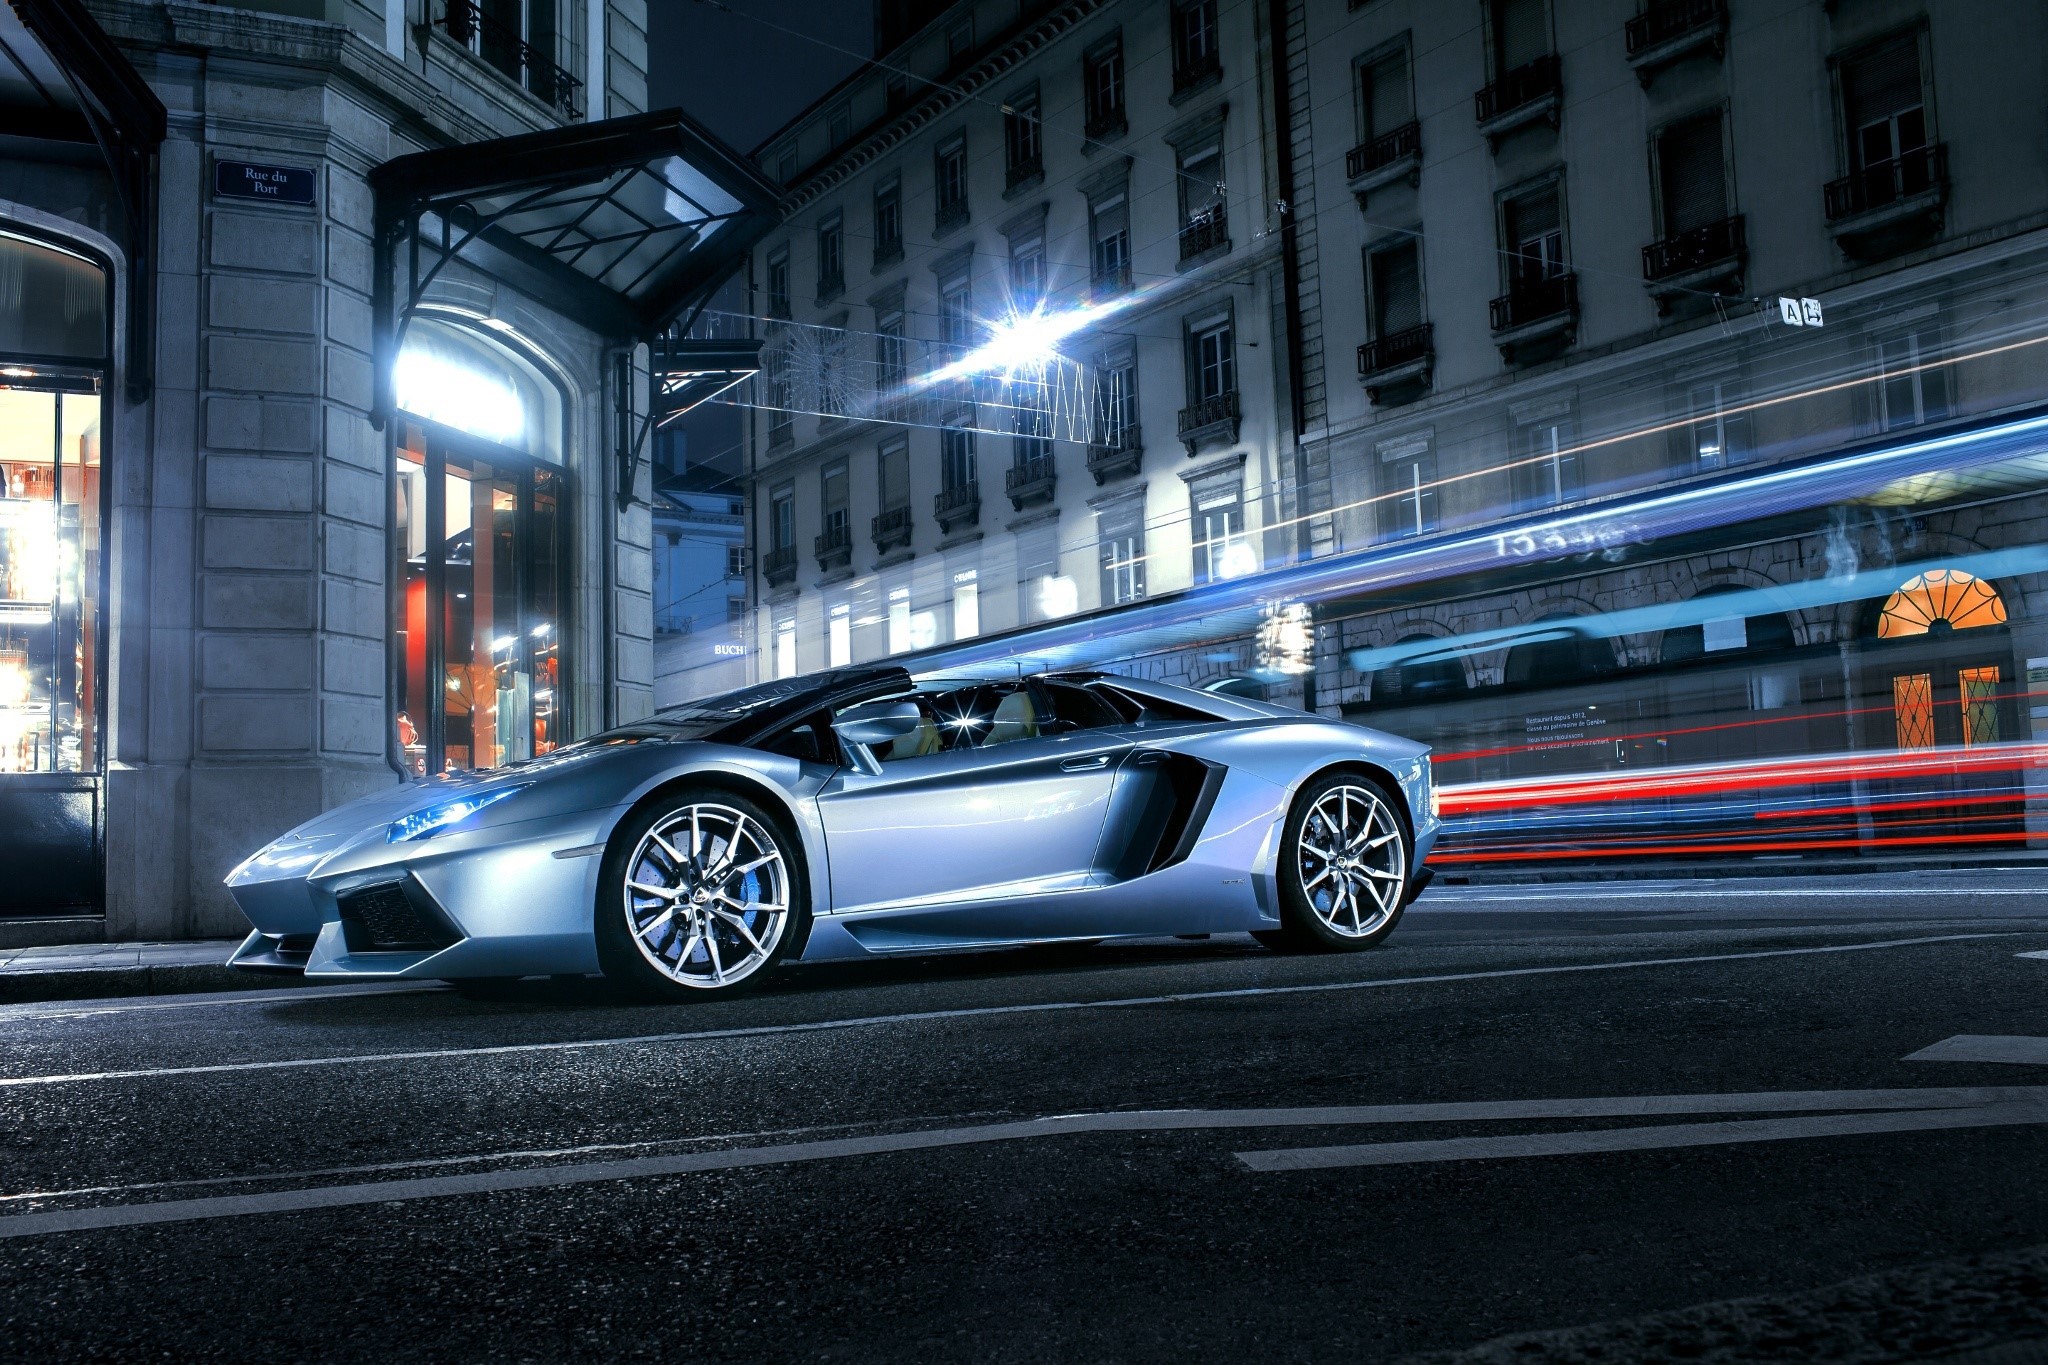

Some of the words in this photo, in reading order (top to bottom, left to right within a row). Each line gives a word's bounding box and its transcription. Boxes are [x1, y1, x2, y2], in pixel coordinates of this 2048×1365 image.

[245, 167, 268, 180] Rue
[272, 171, 288, 183] du
[254, 181, 279, 194] Port
[1788, 304, 1798, 320] A
